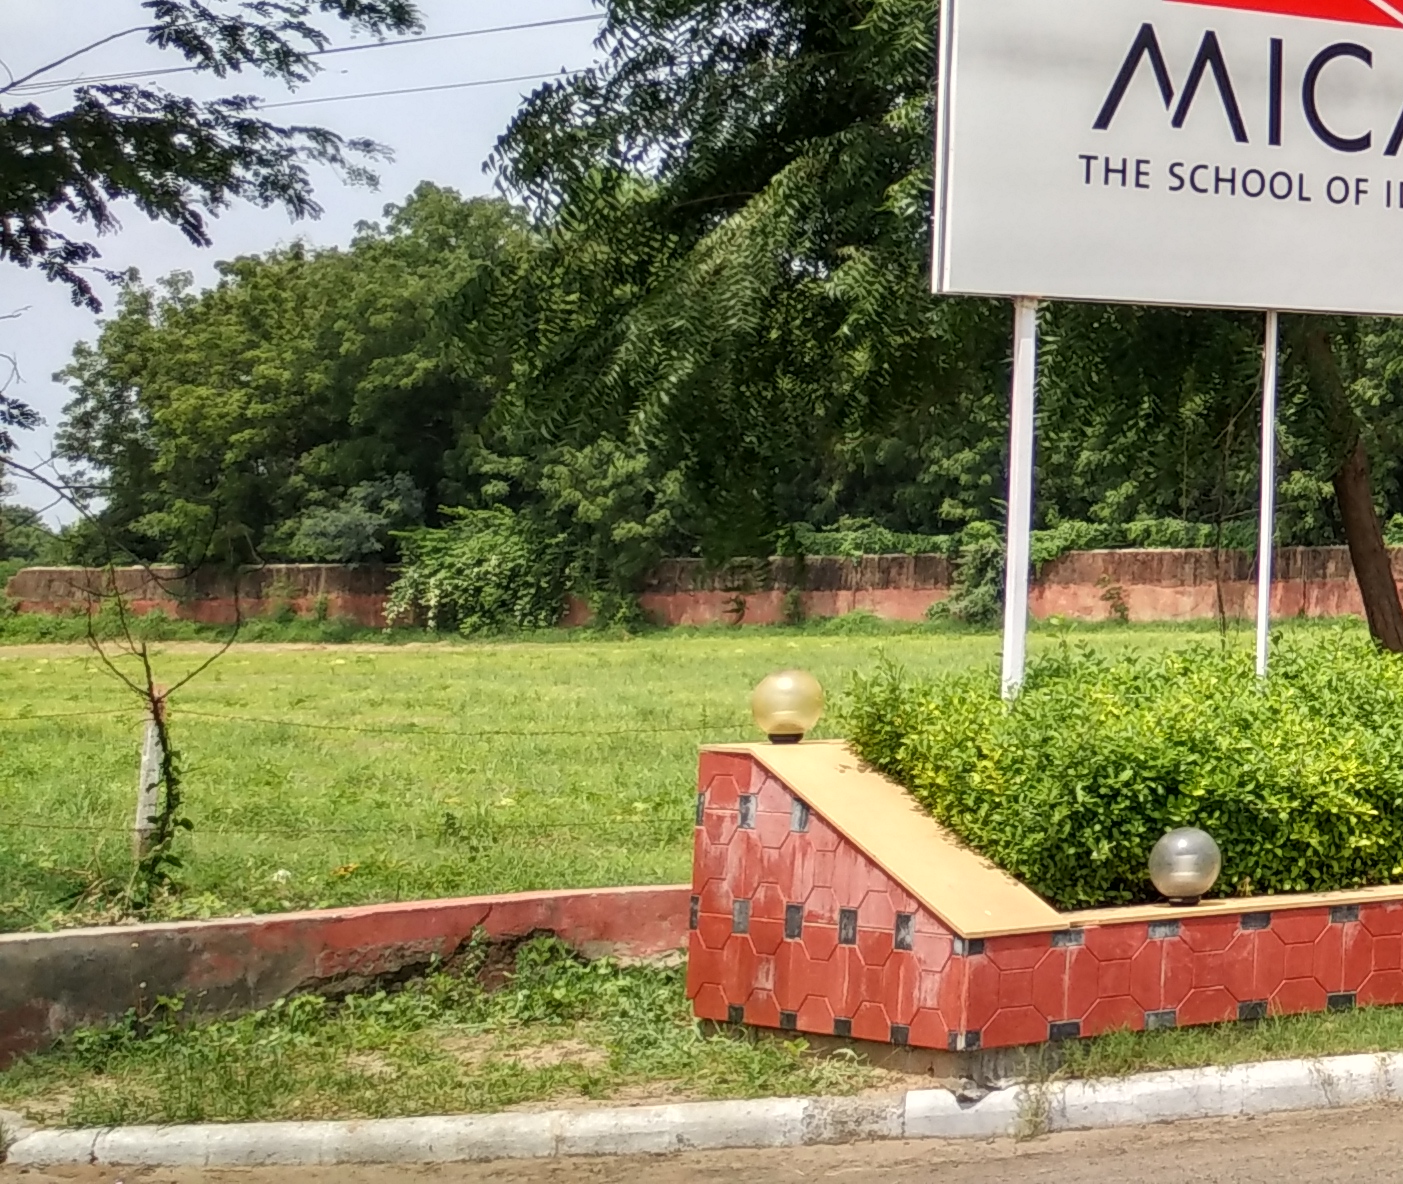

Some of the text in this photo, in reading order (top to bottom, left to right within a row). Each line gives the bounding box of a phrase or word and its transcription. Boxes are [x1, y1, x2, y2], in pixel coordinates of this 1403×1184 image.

[1078, 153, 1151, 189] THE
[1168, 161, 1312, 203] SCHOOL
[1325, 175, 1370, 206] OF
